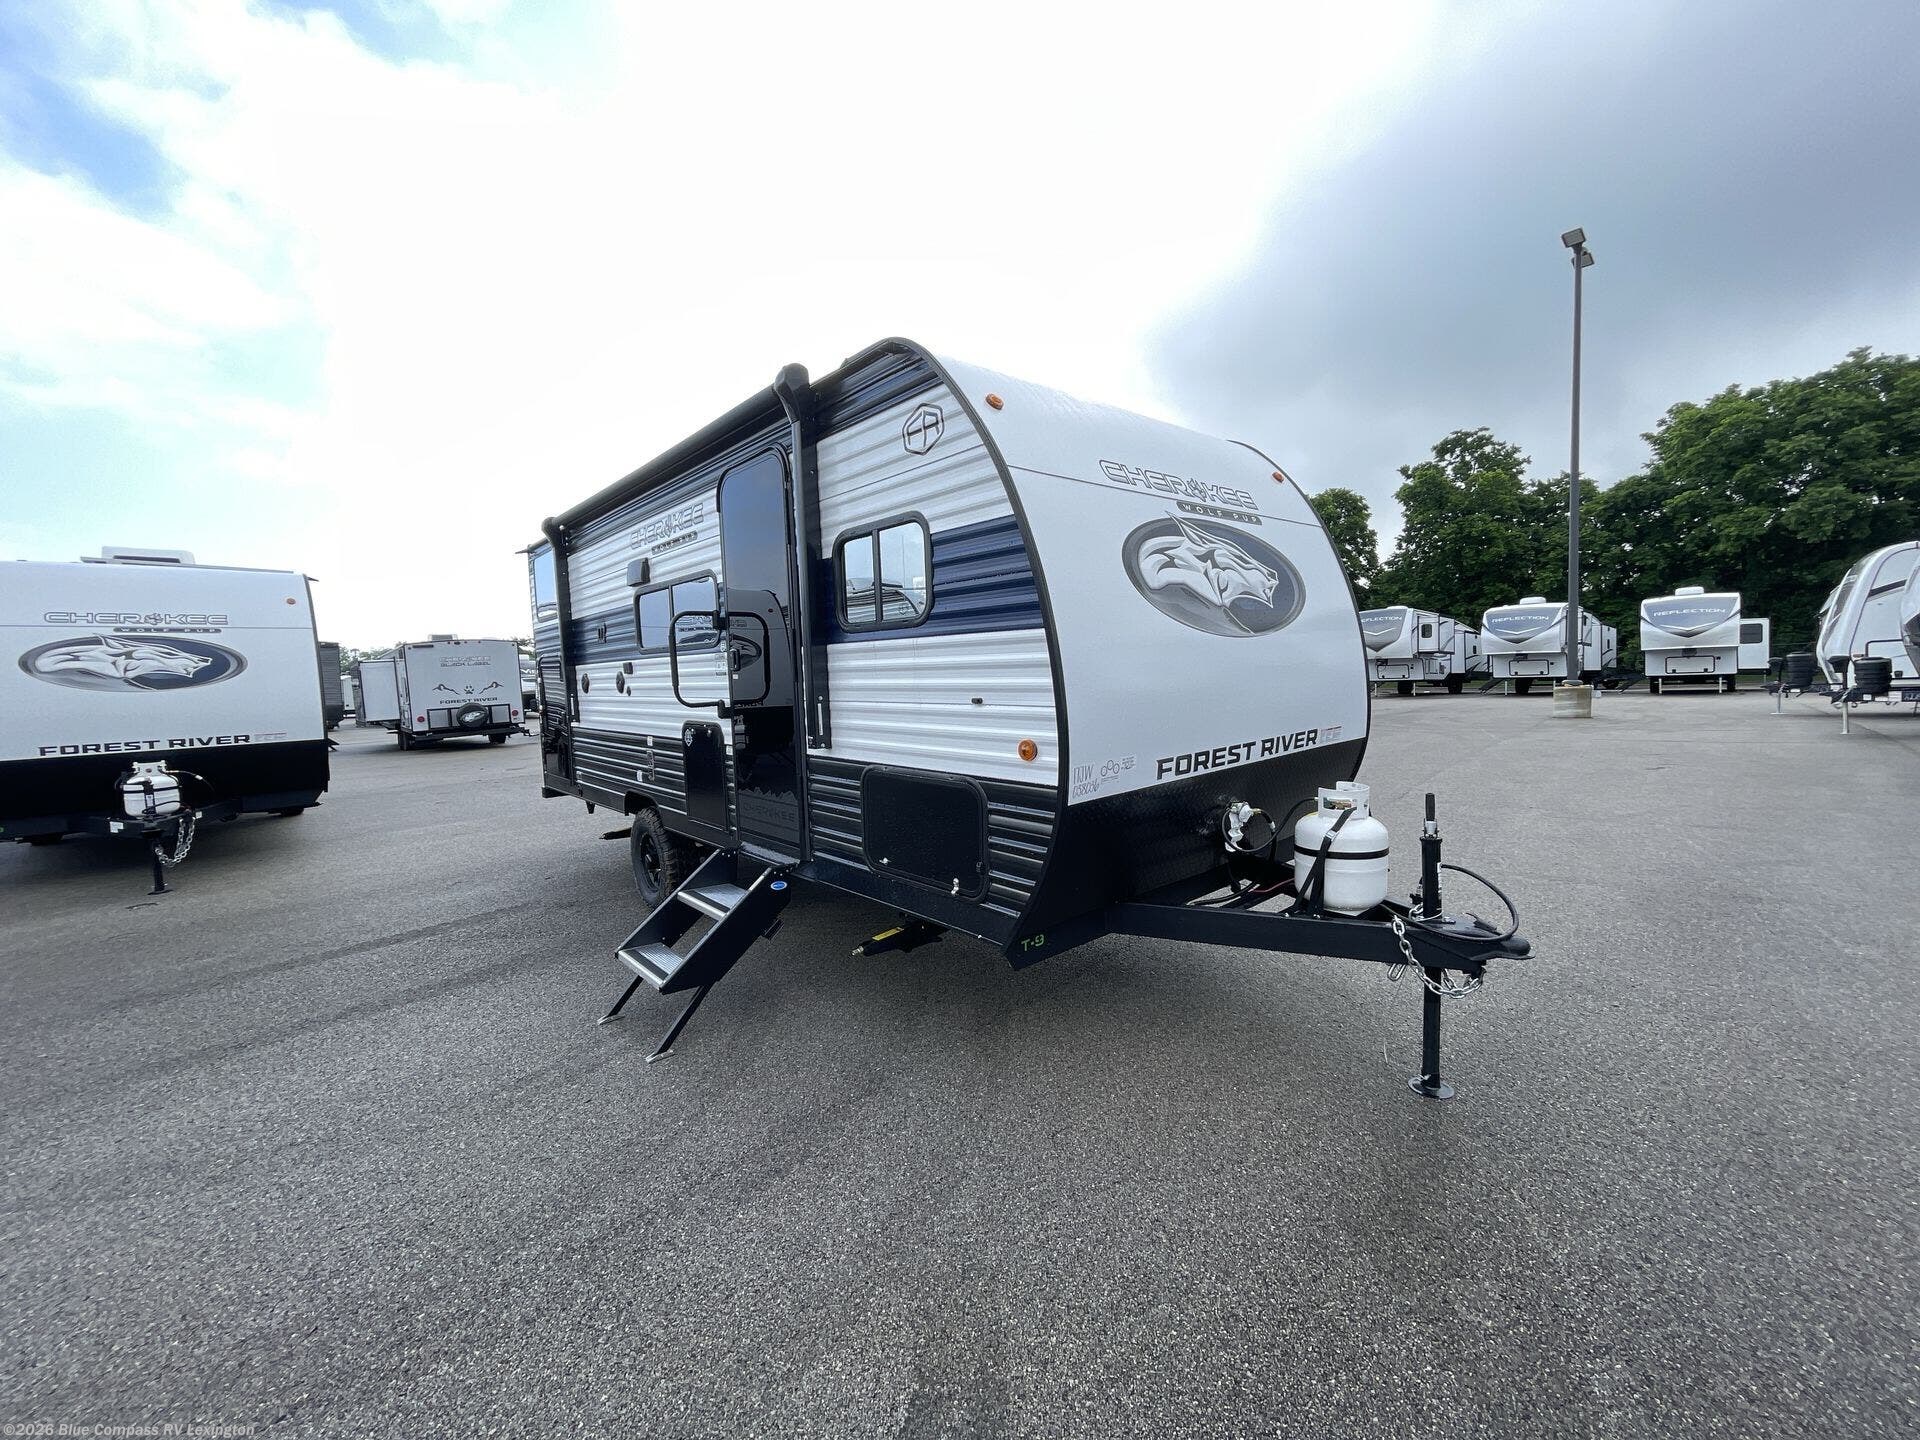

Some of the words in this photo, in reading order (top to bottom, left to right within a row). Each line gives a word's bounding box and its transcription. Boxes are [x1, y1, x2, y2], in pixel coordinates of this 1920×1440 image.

[1099, 460, 1258, 510] CHEROKEE
[1183, 504, 1223, 517] WOLF
[1232, 513, 1257, 522] PUP
[44, 612, 229, 625] CHEROKEE
[1492, 615, 1549, 623] REFLECTION
[1653, 608, 1726, 616] REFLECTION
[39, 741, 159, 756] FOREST
[167, 734, 250, 749] RIVER
[1156, 741, 1256, 781] FOREST
[1260, 728, 1318, 758] RIVER
